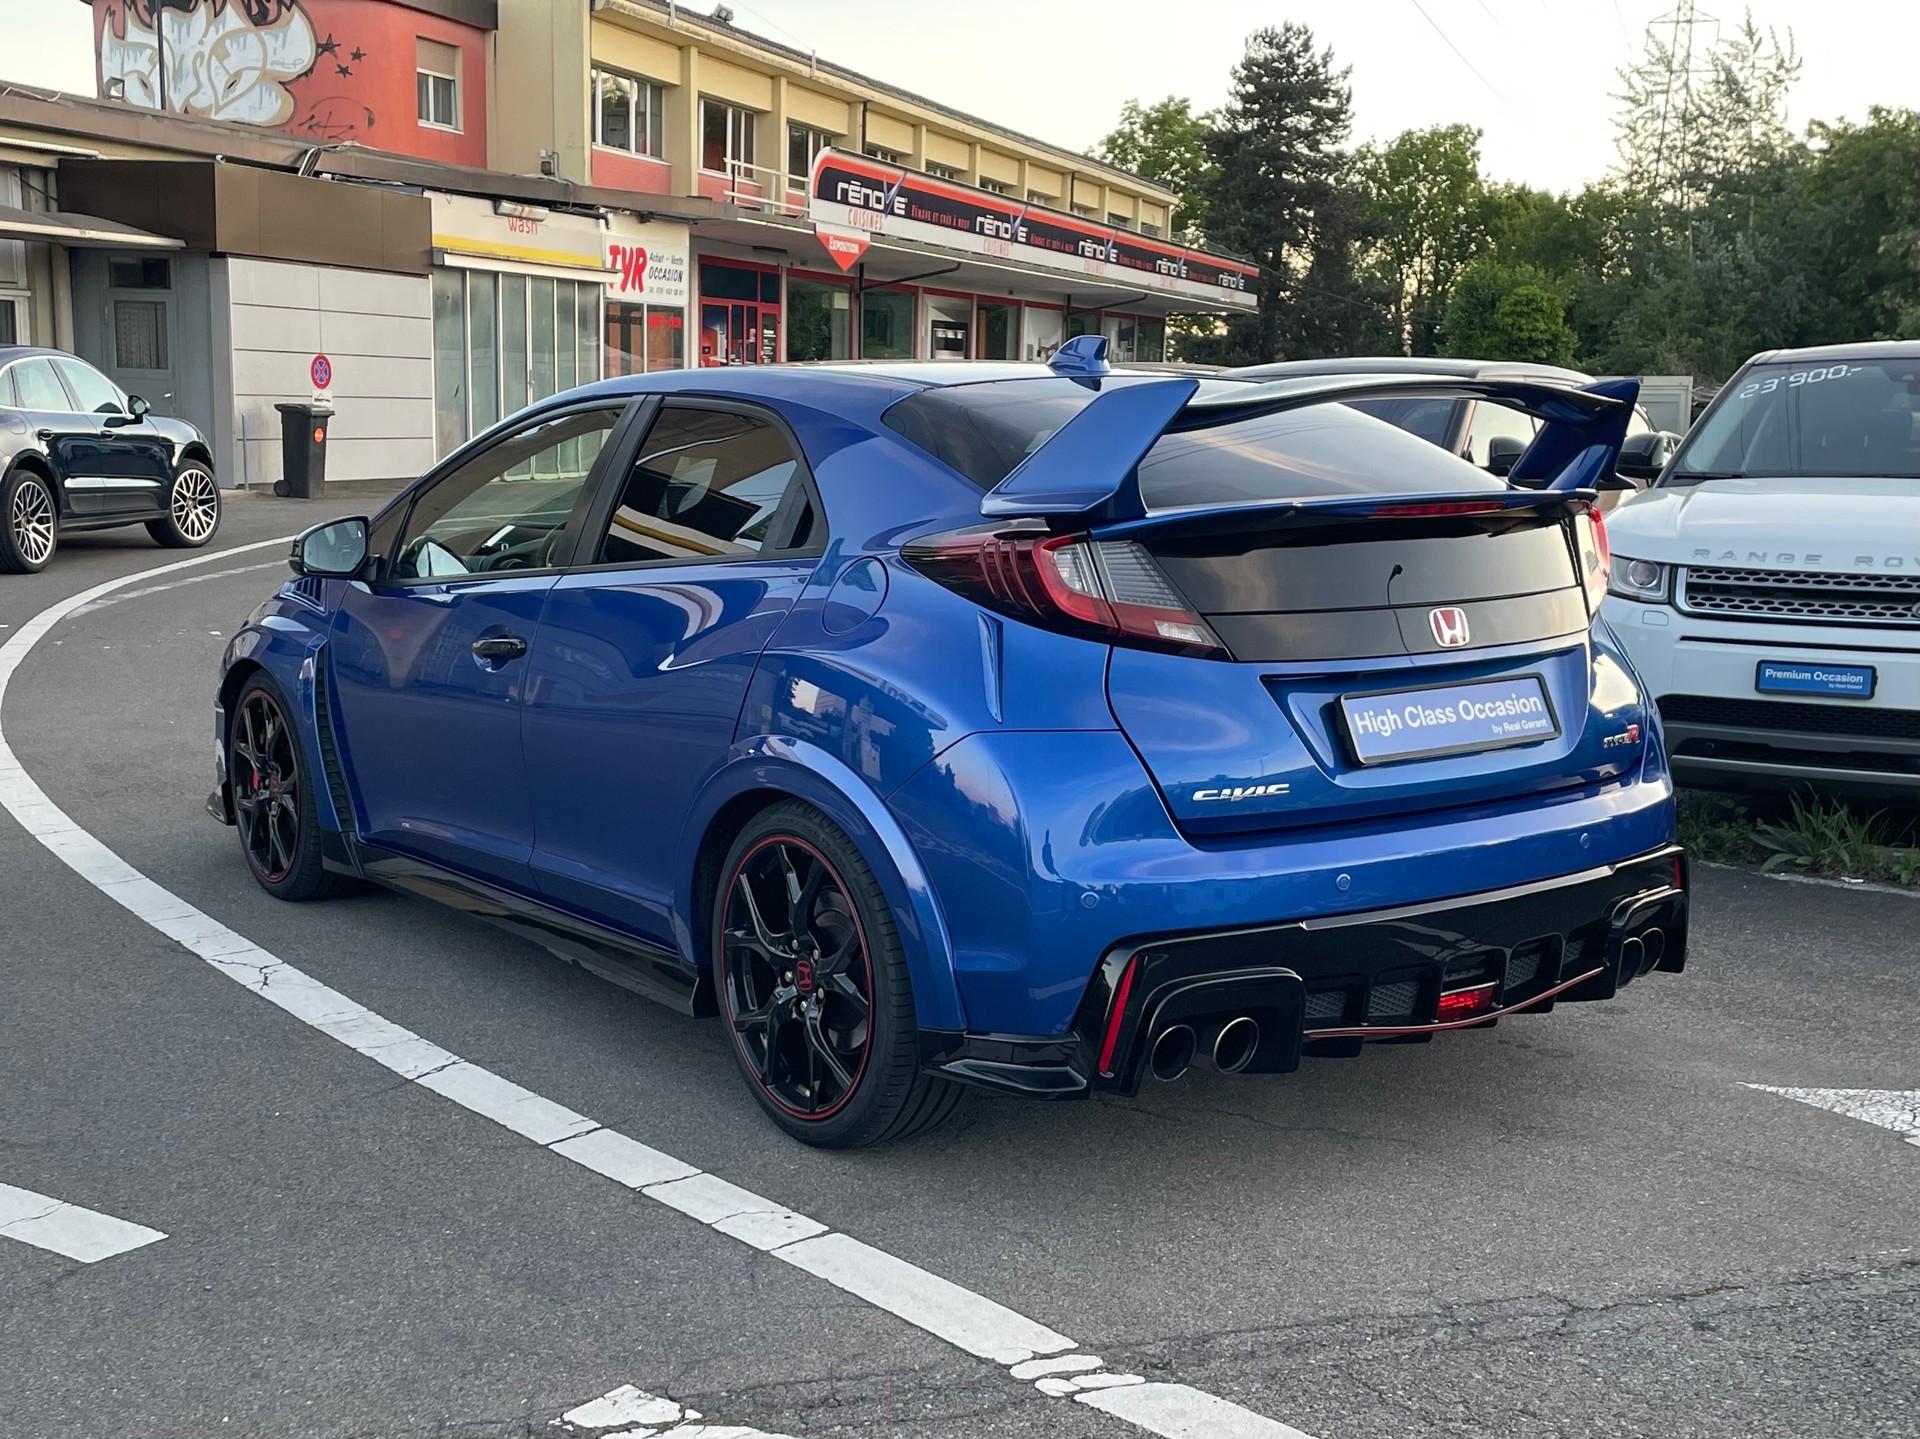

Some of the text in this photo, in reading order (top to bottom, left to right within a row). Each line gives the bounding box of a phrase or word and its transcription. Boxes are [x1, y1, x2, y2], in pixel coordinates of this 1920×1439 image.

[847, 207, 883, 231] CUISINES
[608, 244, 648, 294] TYR
[648, 266, 684, 283] OCCASION
[1691, 548, 1824, 566] RANGE
[1765, 668, 1864, 684] Premium Occasion
[1354, 692, 1543, 737] High Class Occasion
[1491, 717, 1548, 735] by Real Garant
[1192, 783, 1290, 802] CIVIC
